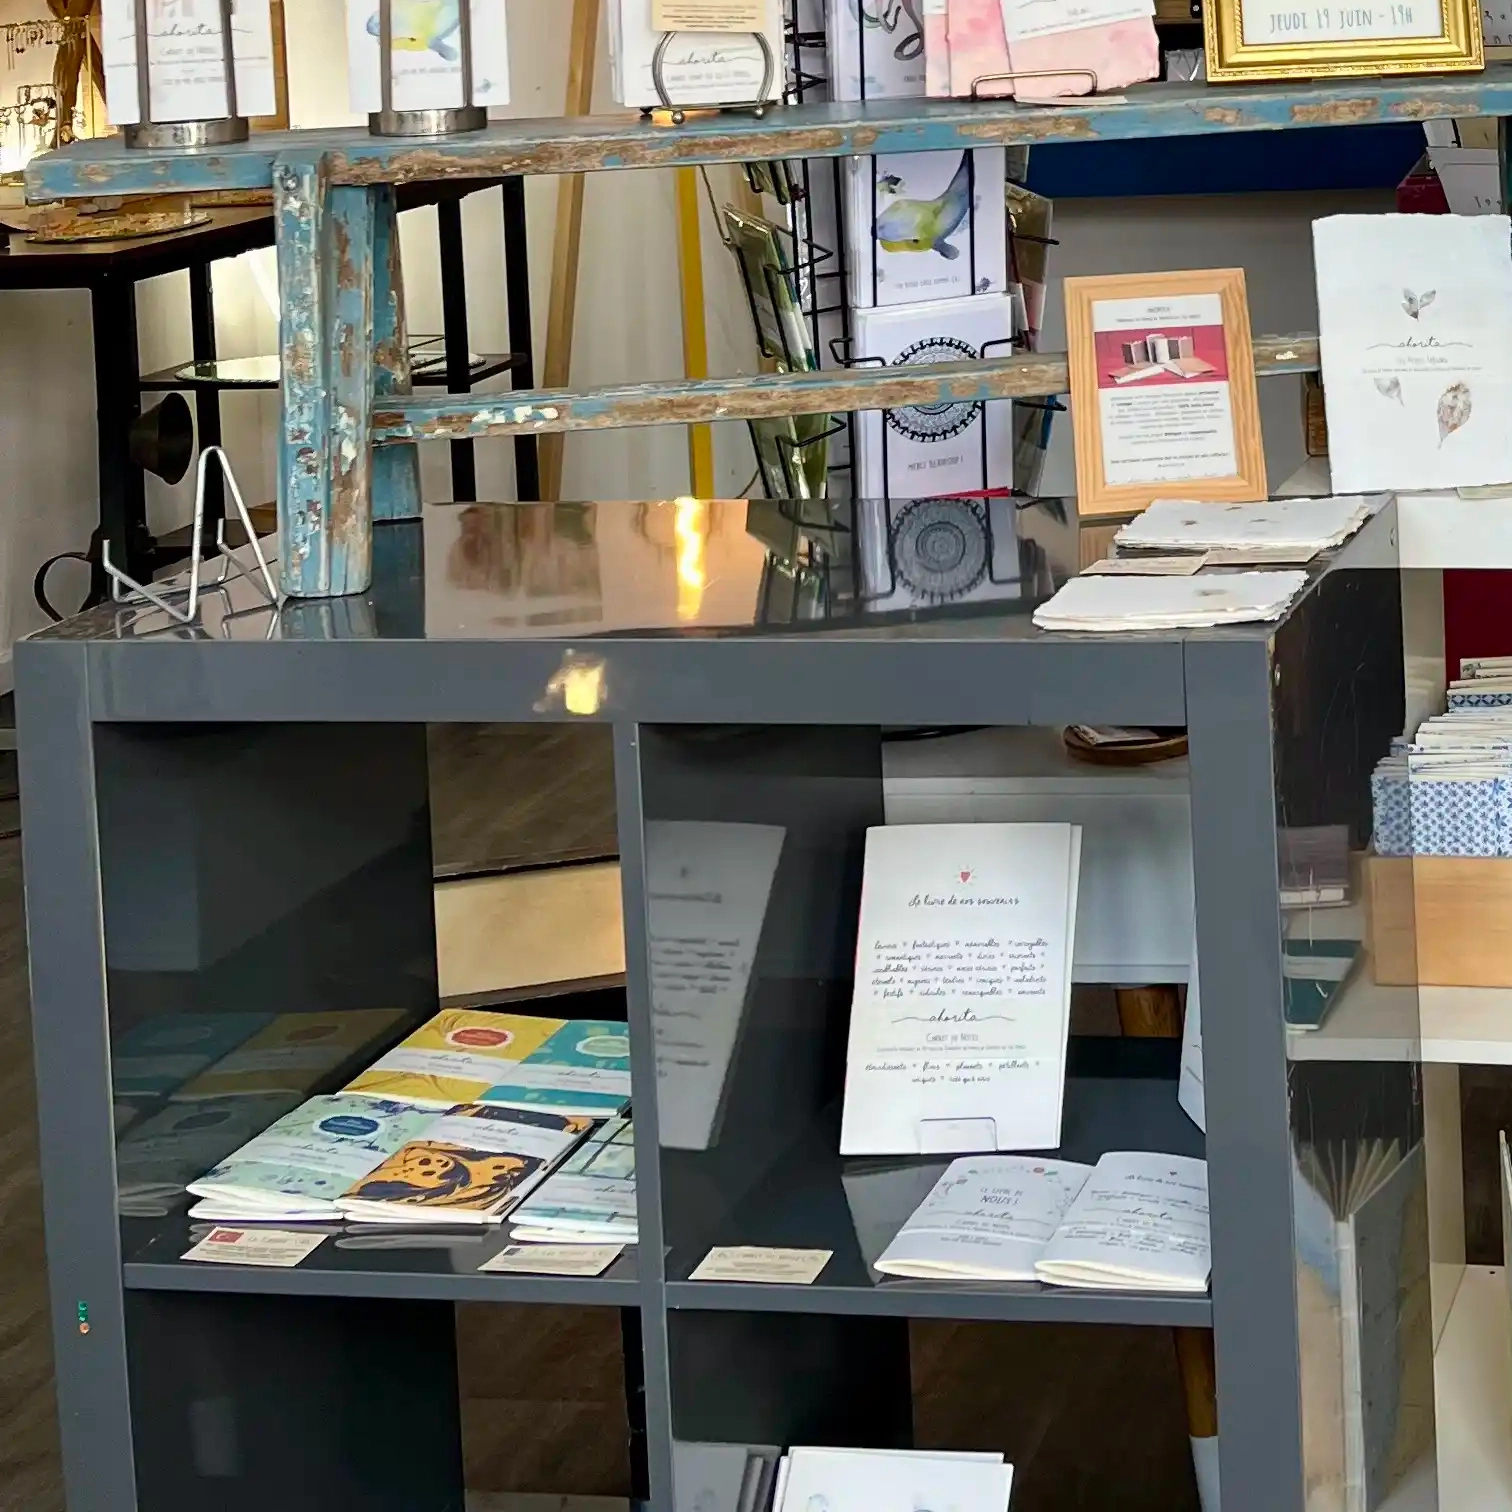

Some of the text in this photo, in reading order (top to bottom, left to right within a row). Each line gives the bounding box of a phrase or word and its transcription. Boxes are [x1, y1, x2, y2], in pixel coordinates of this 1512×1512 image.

[1269, 11, 1308, 34] JEUDI
[1316, 8, 1330, 29] 19
[1339, 9, 1373, 30] JUIN
